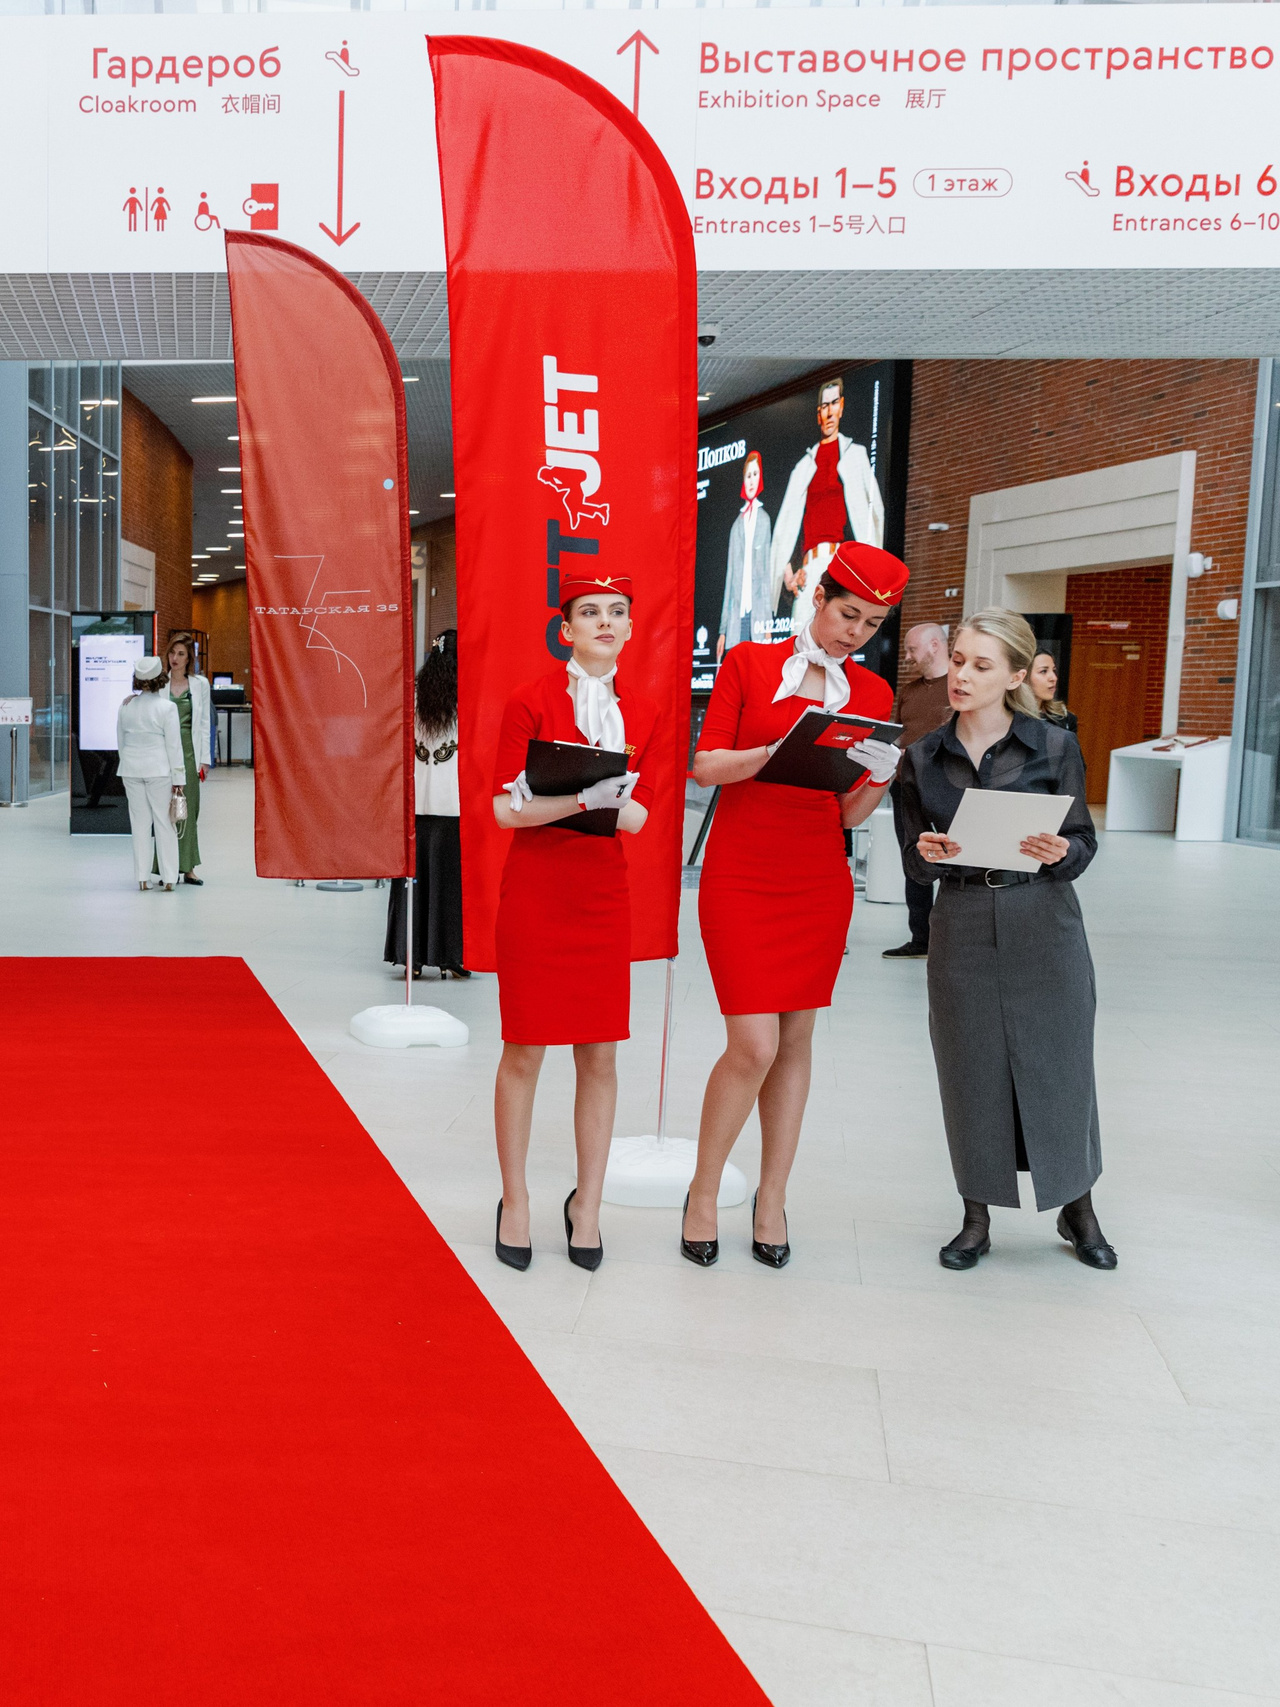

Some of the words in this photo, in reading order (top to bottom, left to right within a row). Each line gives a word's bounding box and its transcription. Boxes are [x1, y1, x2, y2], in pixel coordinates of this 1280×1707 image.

[92, 46, 282, 88] Гардероб
[699, 42, 967, 74] Выставочное
[981, 46, 1275, 80] пространство
[78, 95, 197, 113] Cloakroom
[221, 94, 281, 114] 衣帽间
[698, 90, 808, 109] Exhibition
[816, 89, 881, 112] Space
[905, 88, 947, 109] 展厅
[695, 168, 819, 204] Входы
[927, 173, 937, 192] 1
[943, 177, 998, 192] этаж
[1115, 165, 1241, 202] Входы
[1256, 164, 1277, 197] 6
[693, 215, 801, 234] Entrances
[1113, 213, 1222, 231] Entrances
[542, 355, 602, 498] JET
[697, 439, 746, 472] Попков
[255, 605, 370, 615] ТАТАРСКАЯ
[376, 604, 399, 612] 35
